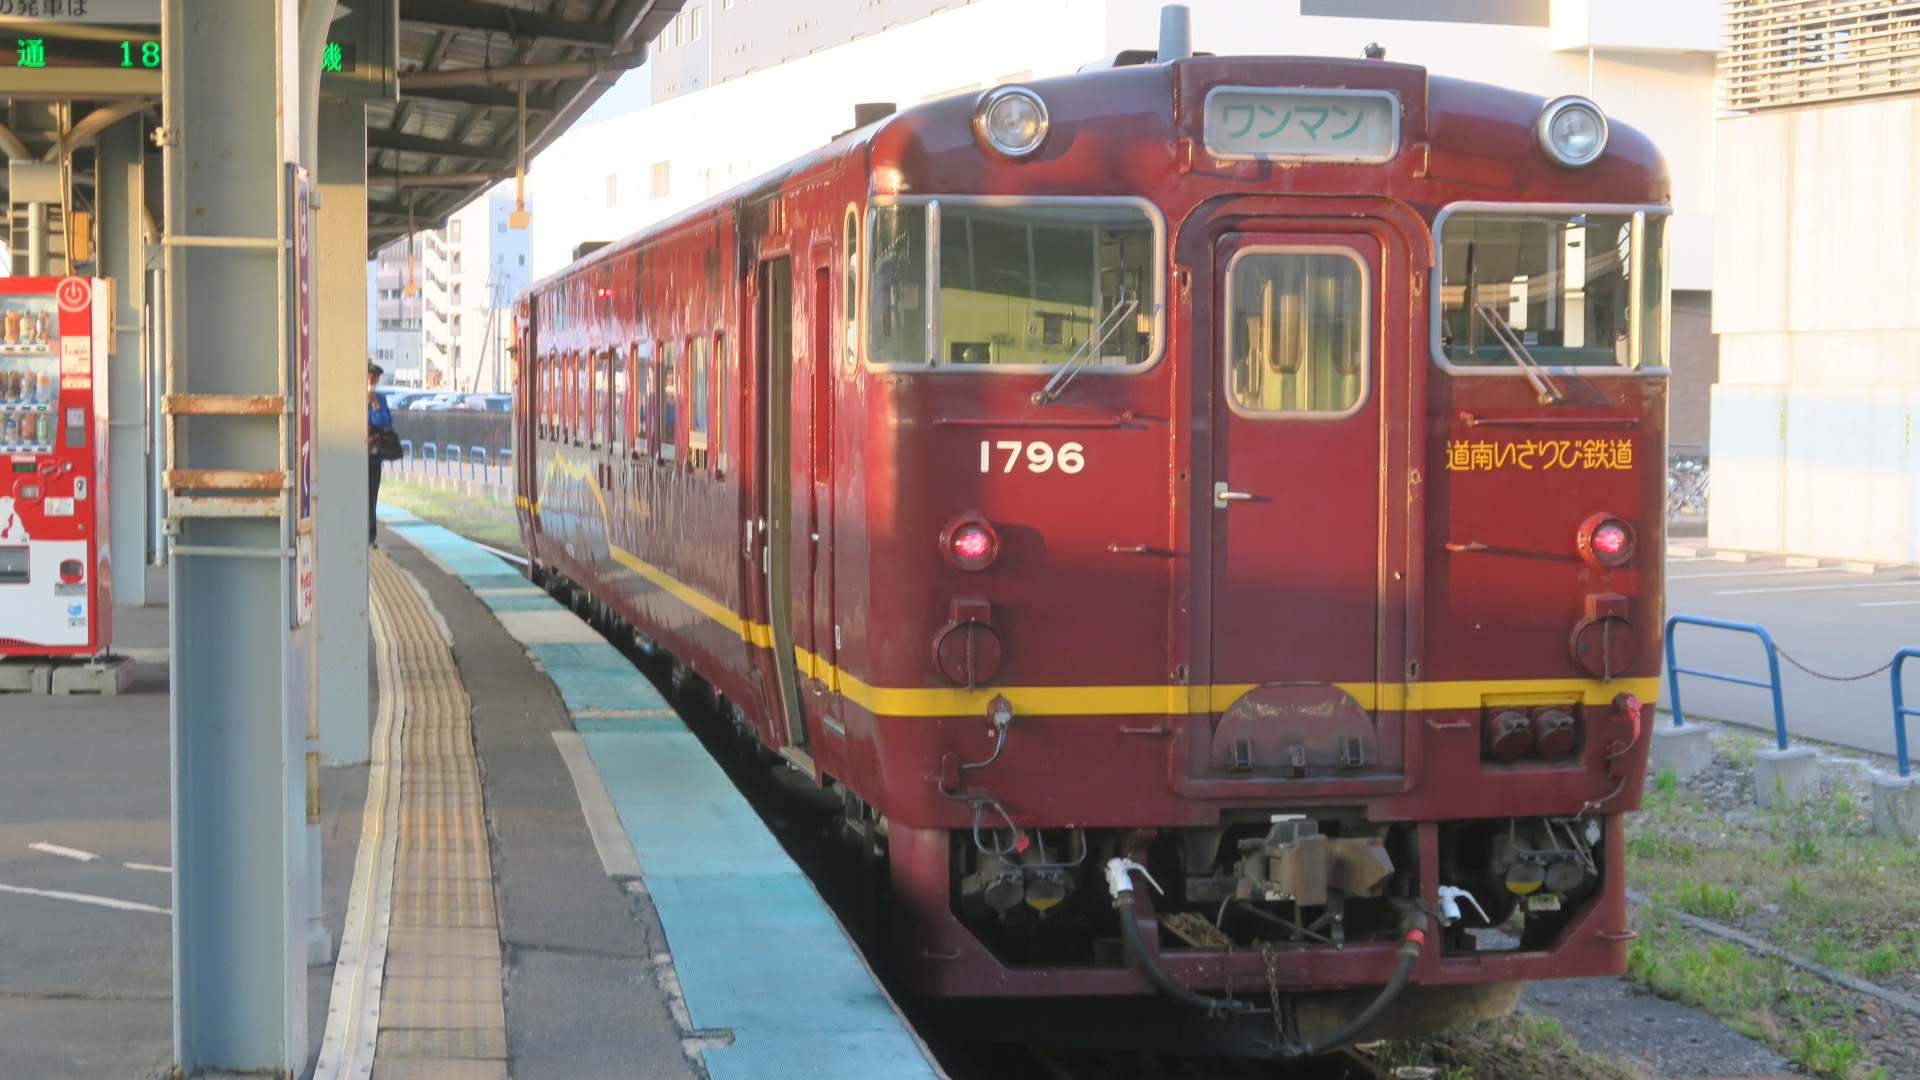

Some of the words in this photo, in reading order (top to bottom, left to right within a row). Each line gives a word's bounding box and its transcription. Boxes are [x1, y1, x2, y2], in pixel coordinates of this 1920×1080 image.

[17, 38, 46, 68] 通
[120, 41, 160, 68] 18
[1222, 104, 1365, 140] ワンマン
[980, 440, 1086, 475] 1796
[1445, 438, 1634, 472] 道南いさりび鉄道
